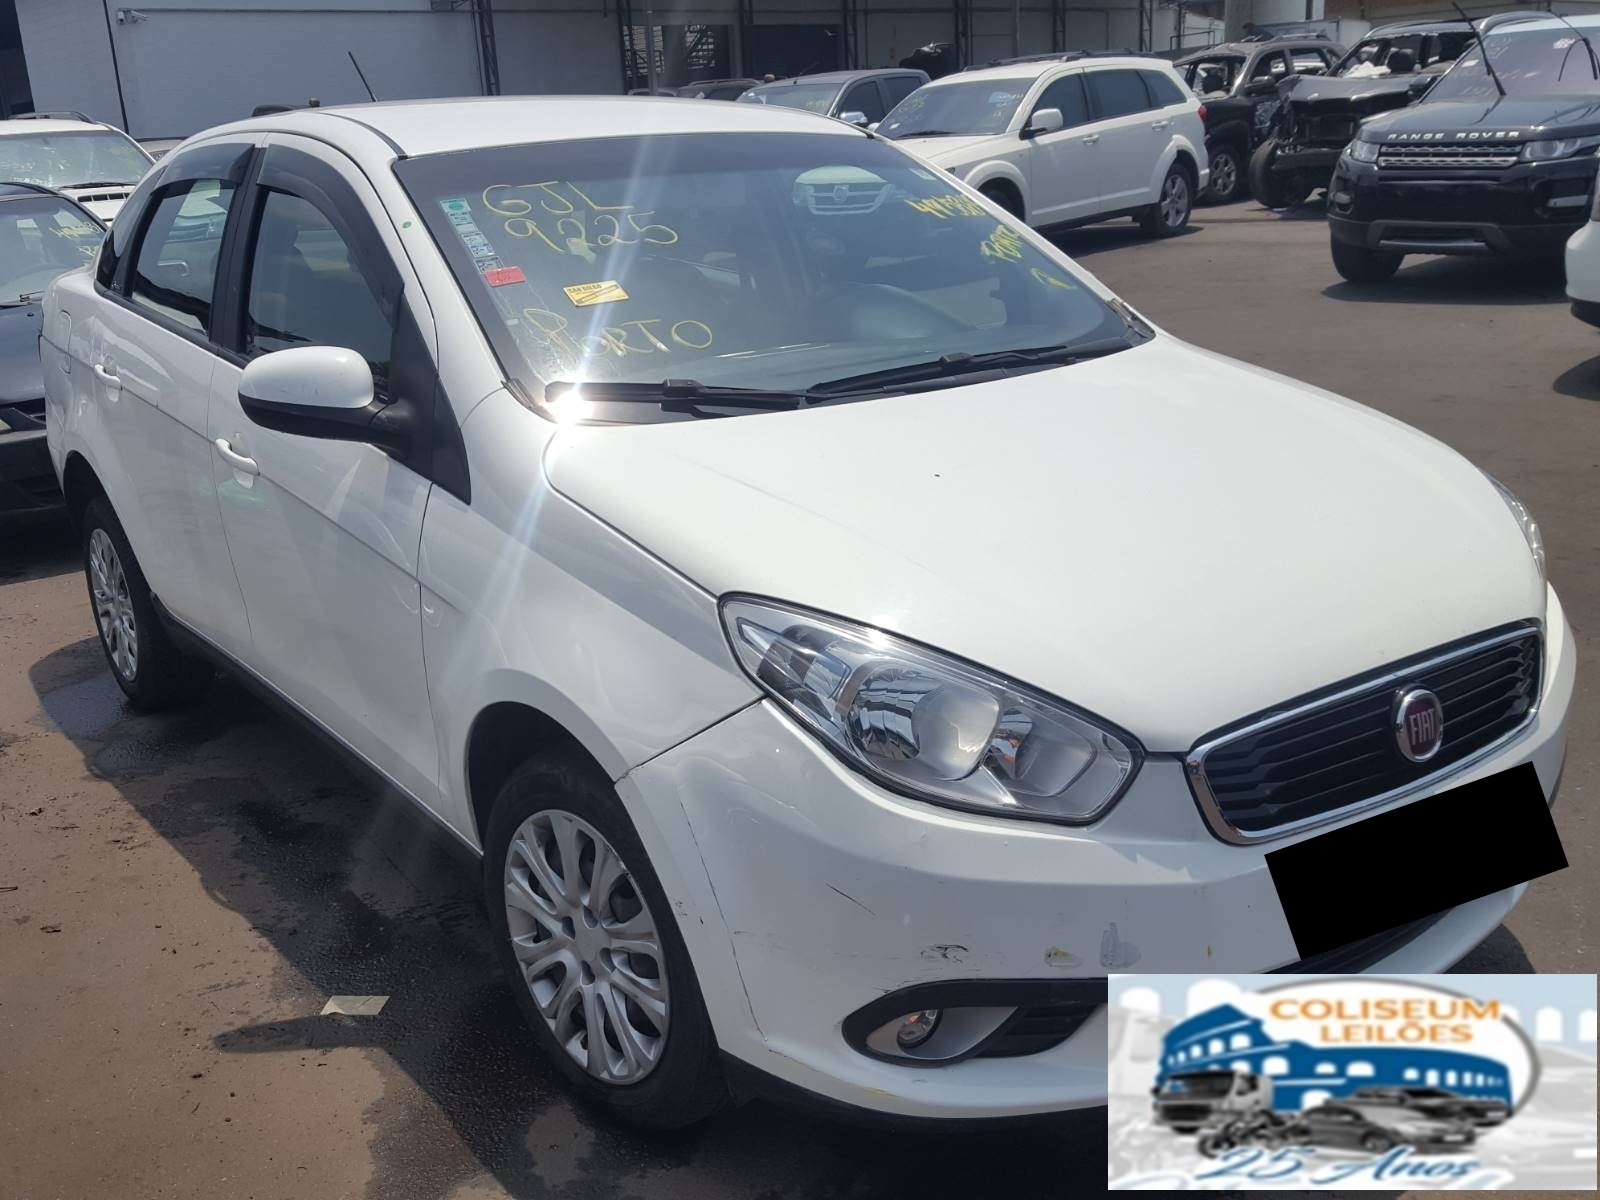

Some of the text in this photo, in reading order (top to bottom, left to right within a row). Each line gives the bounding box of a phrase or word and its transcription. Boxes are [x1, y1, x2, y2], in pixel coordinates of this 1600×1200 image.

[1387, 131, 1520, 140] RANGE ROVER
[504, 210, 679, 253] 9225
[1408, 708, 1435, 746] FIAT
